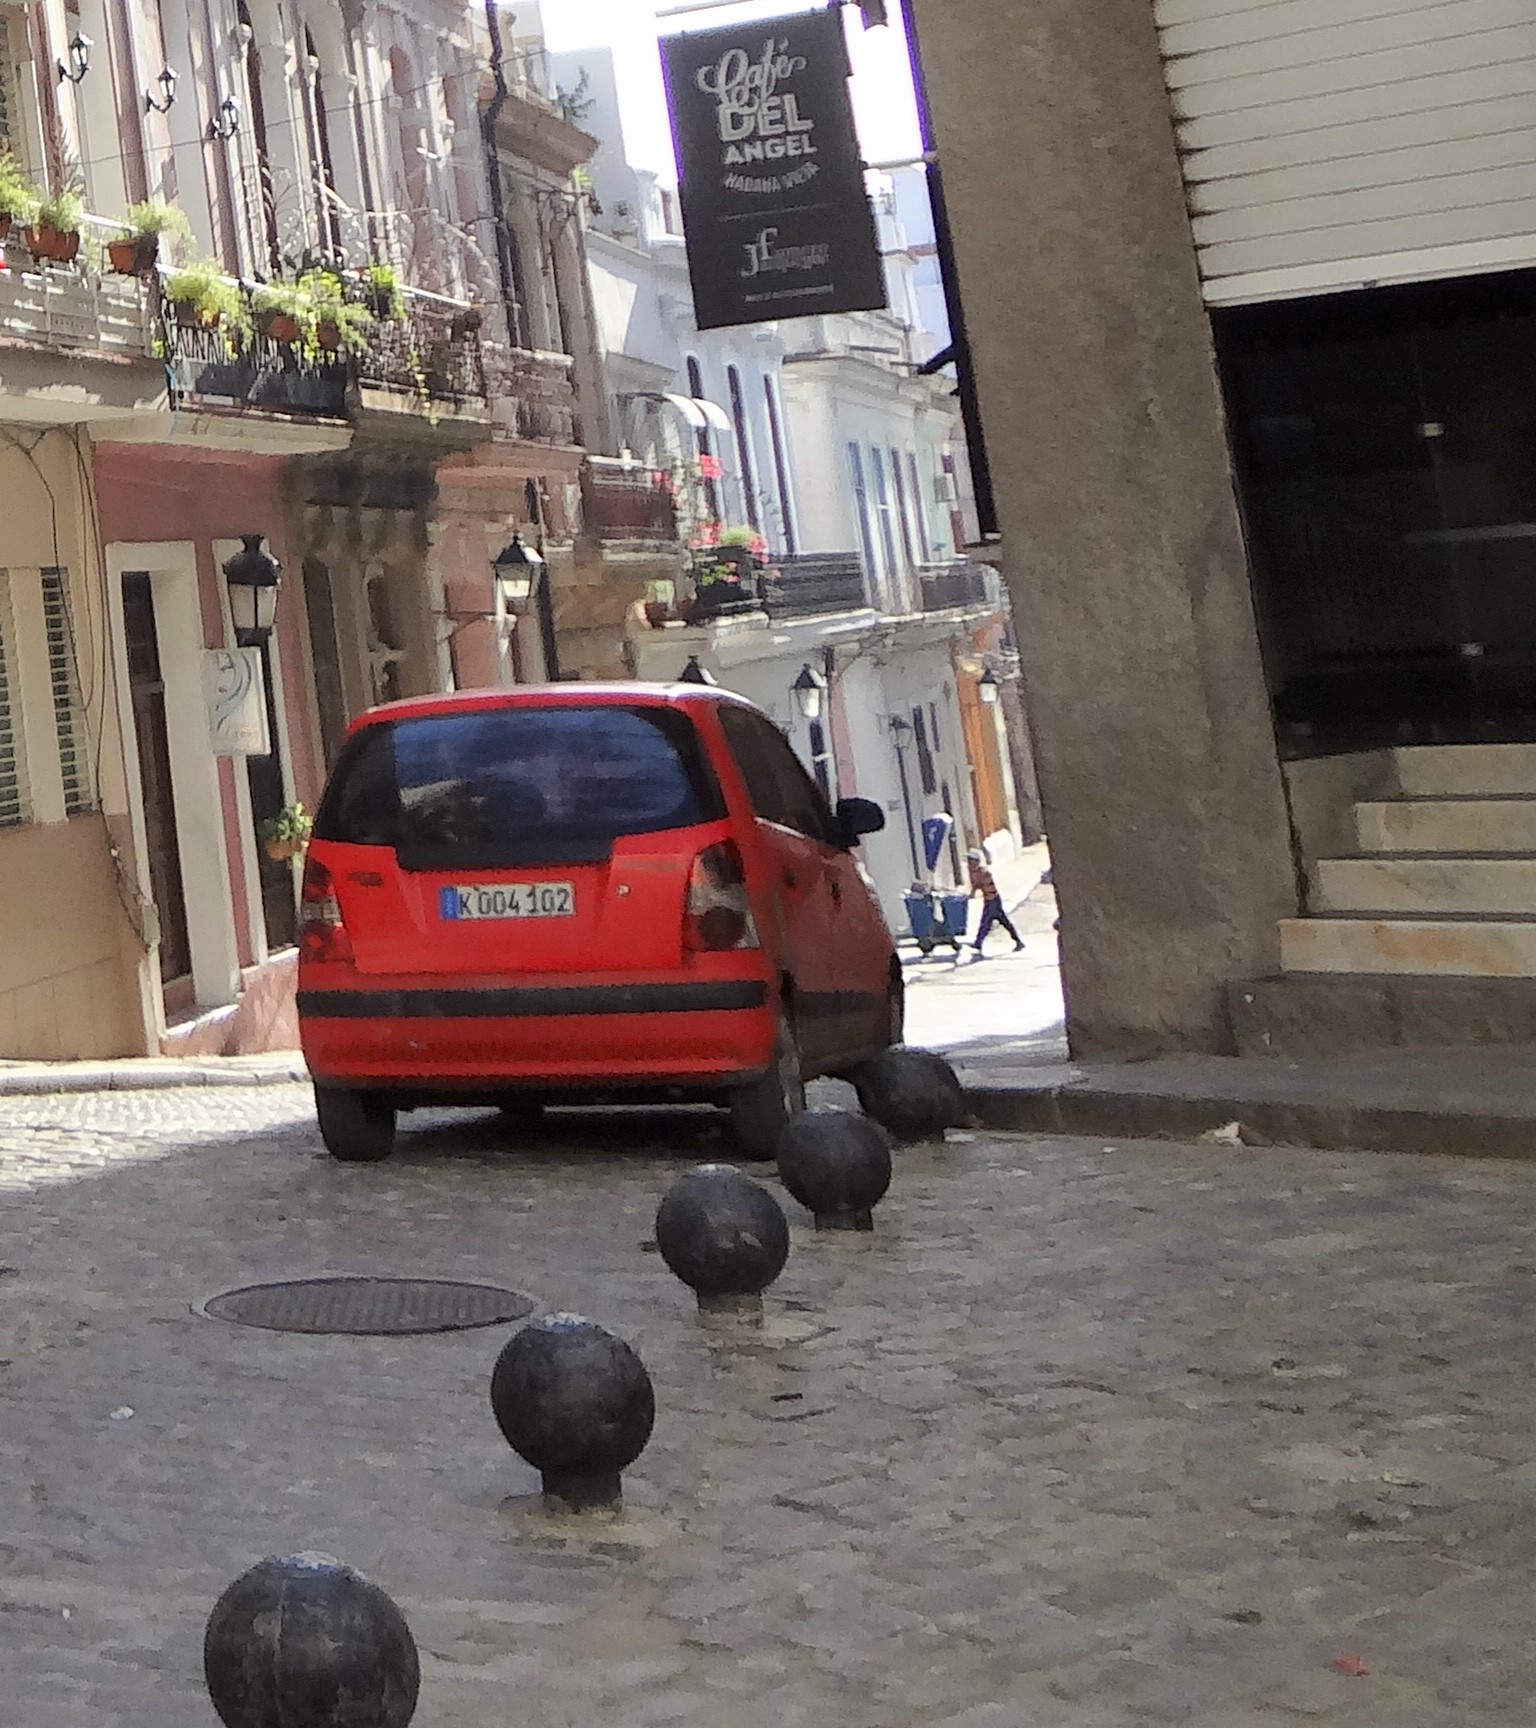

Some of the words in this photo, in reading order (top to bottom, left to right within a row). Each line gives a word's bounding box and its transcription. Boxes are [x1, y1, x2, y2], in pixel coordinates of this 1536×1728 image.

[717, 92, 816, 142] DEL
[723, 133, 818, 165] ANGEL
[459, 892, 472, 915] K
